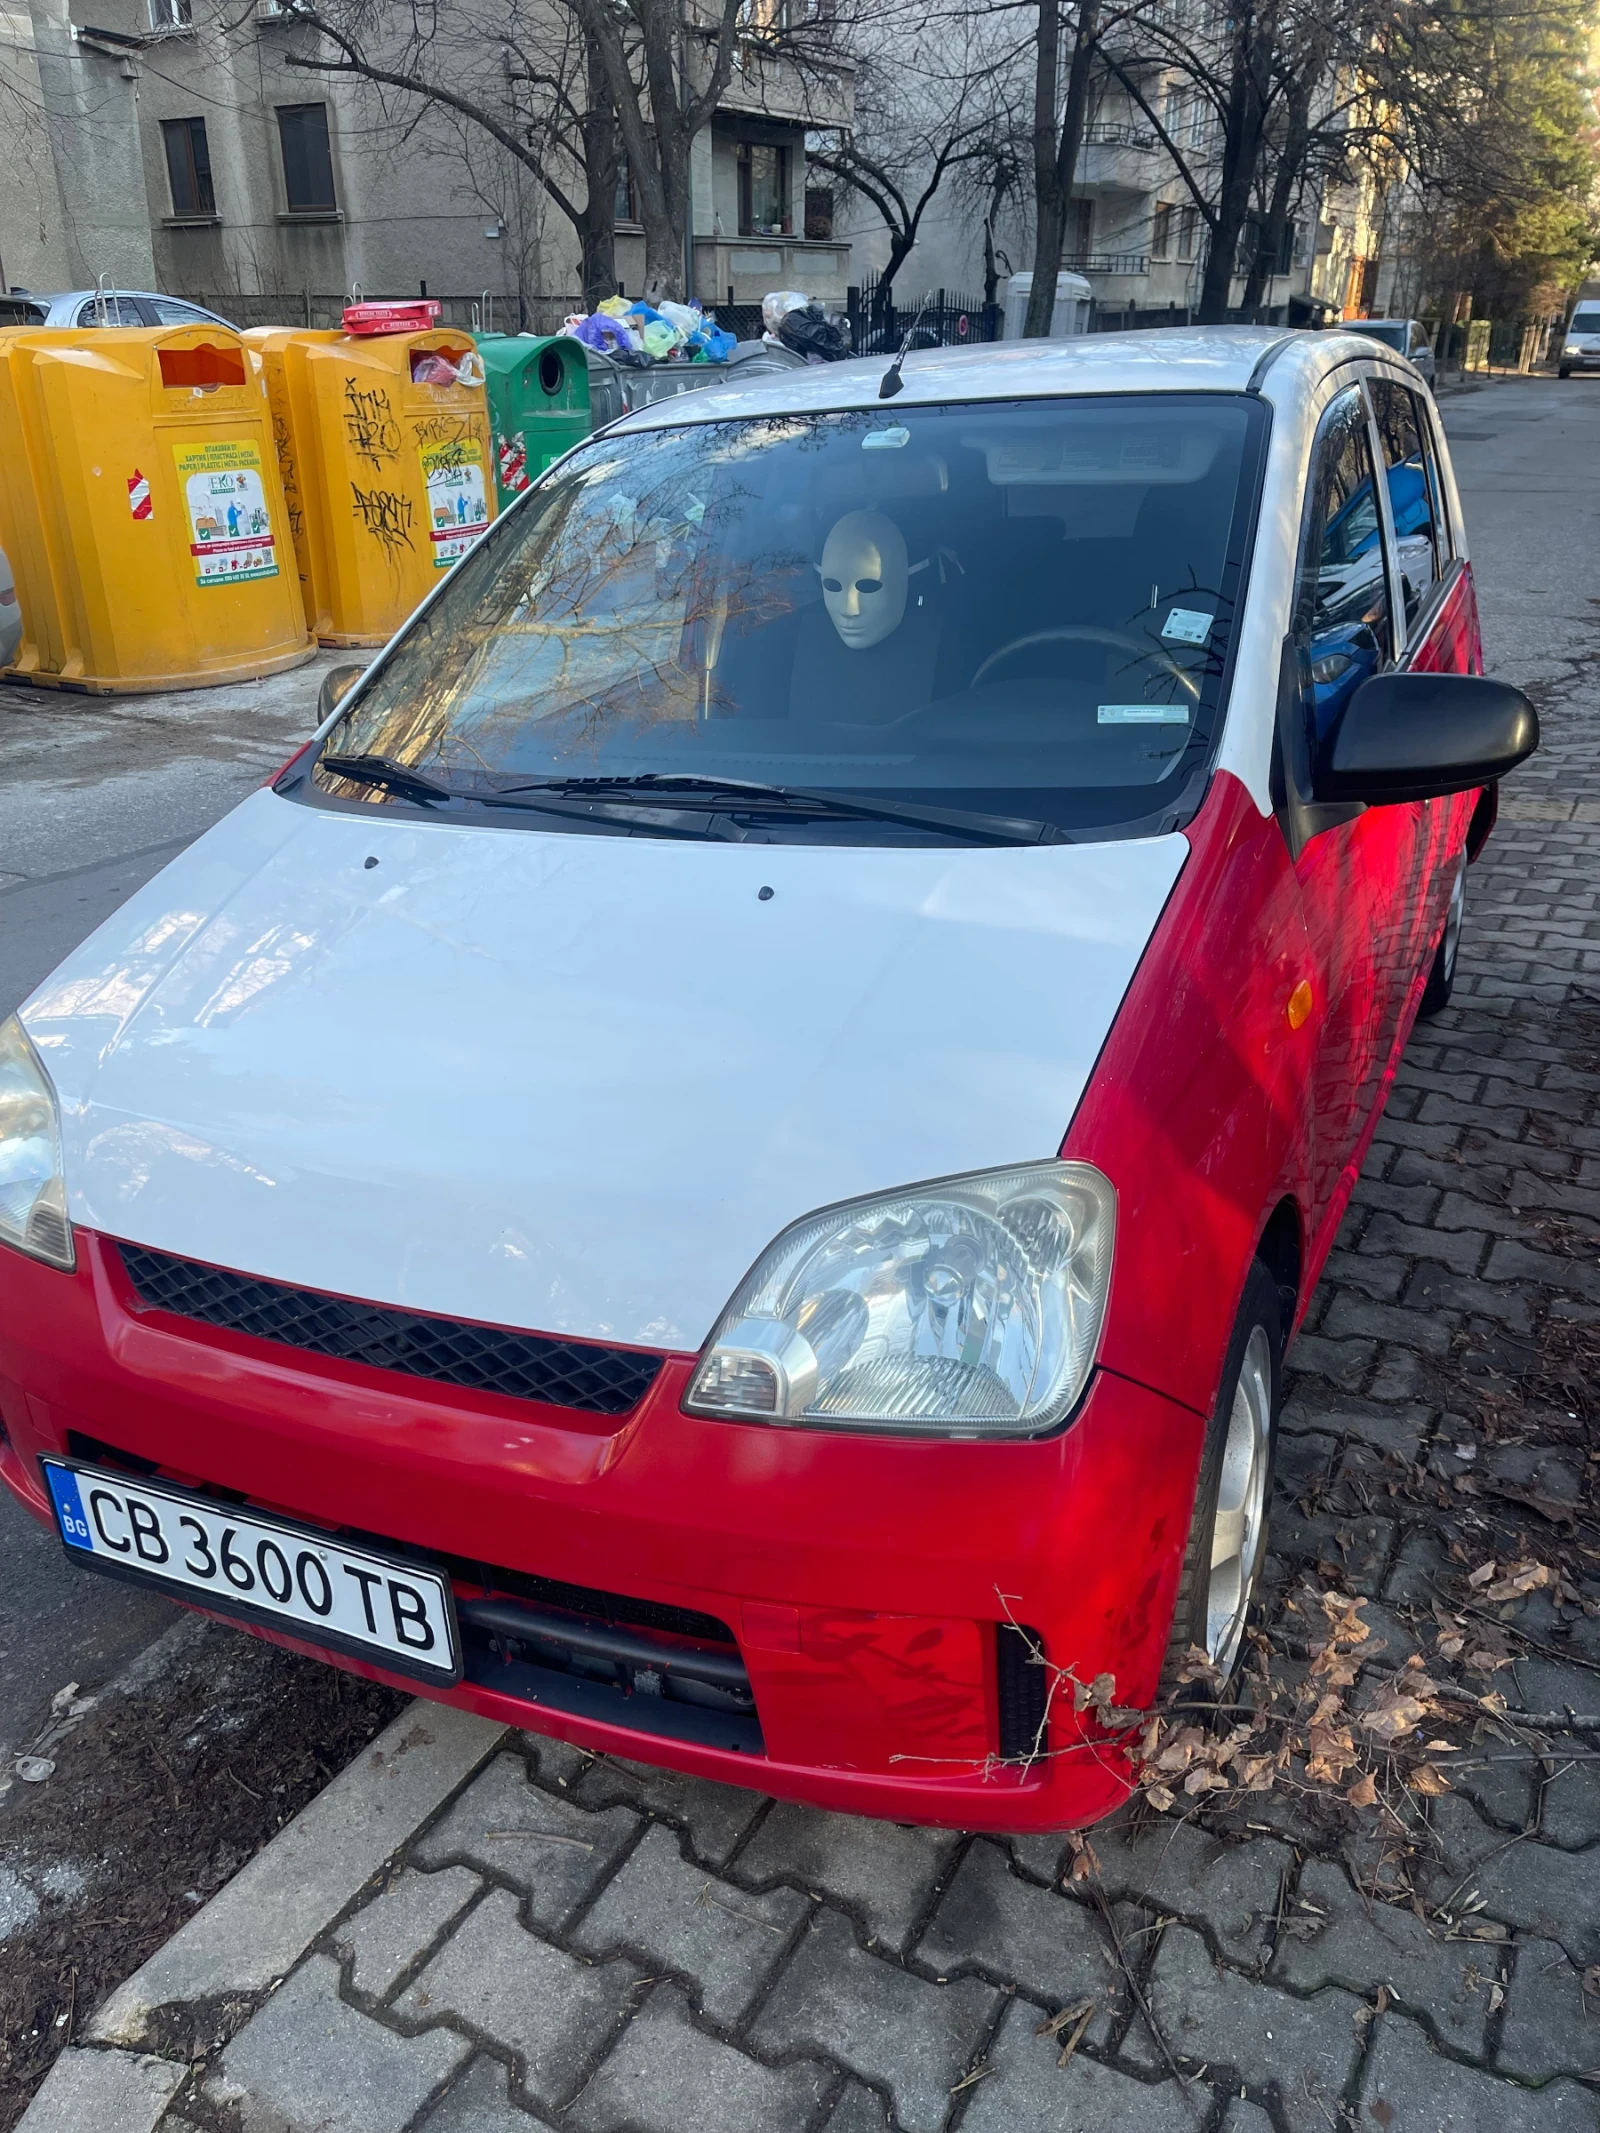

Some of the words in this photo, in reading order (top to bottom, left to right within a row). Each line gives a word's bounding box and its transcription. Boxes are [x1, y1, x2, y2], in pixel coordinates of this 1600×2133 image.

[209, 452, 238, 460] ПЛАСТМАСА
[223, 459, 238, 467] METAL
[64, 1515, 89, 1539] BG
[90, 1488, 170, 1565] CB
[179, 1515, 332, 1617] 3600
[343, 1564, 435, 1651] TB
